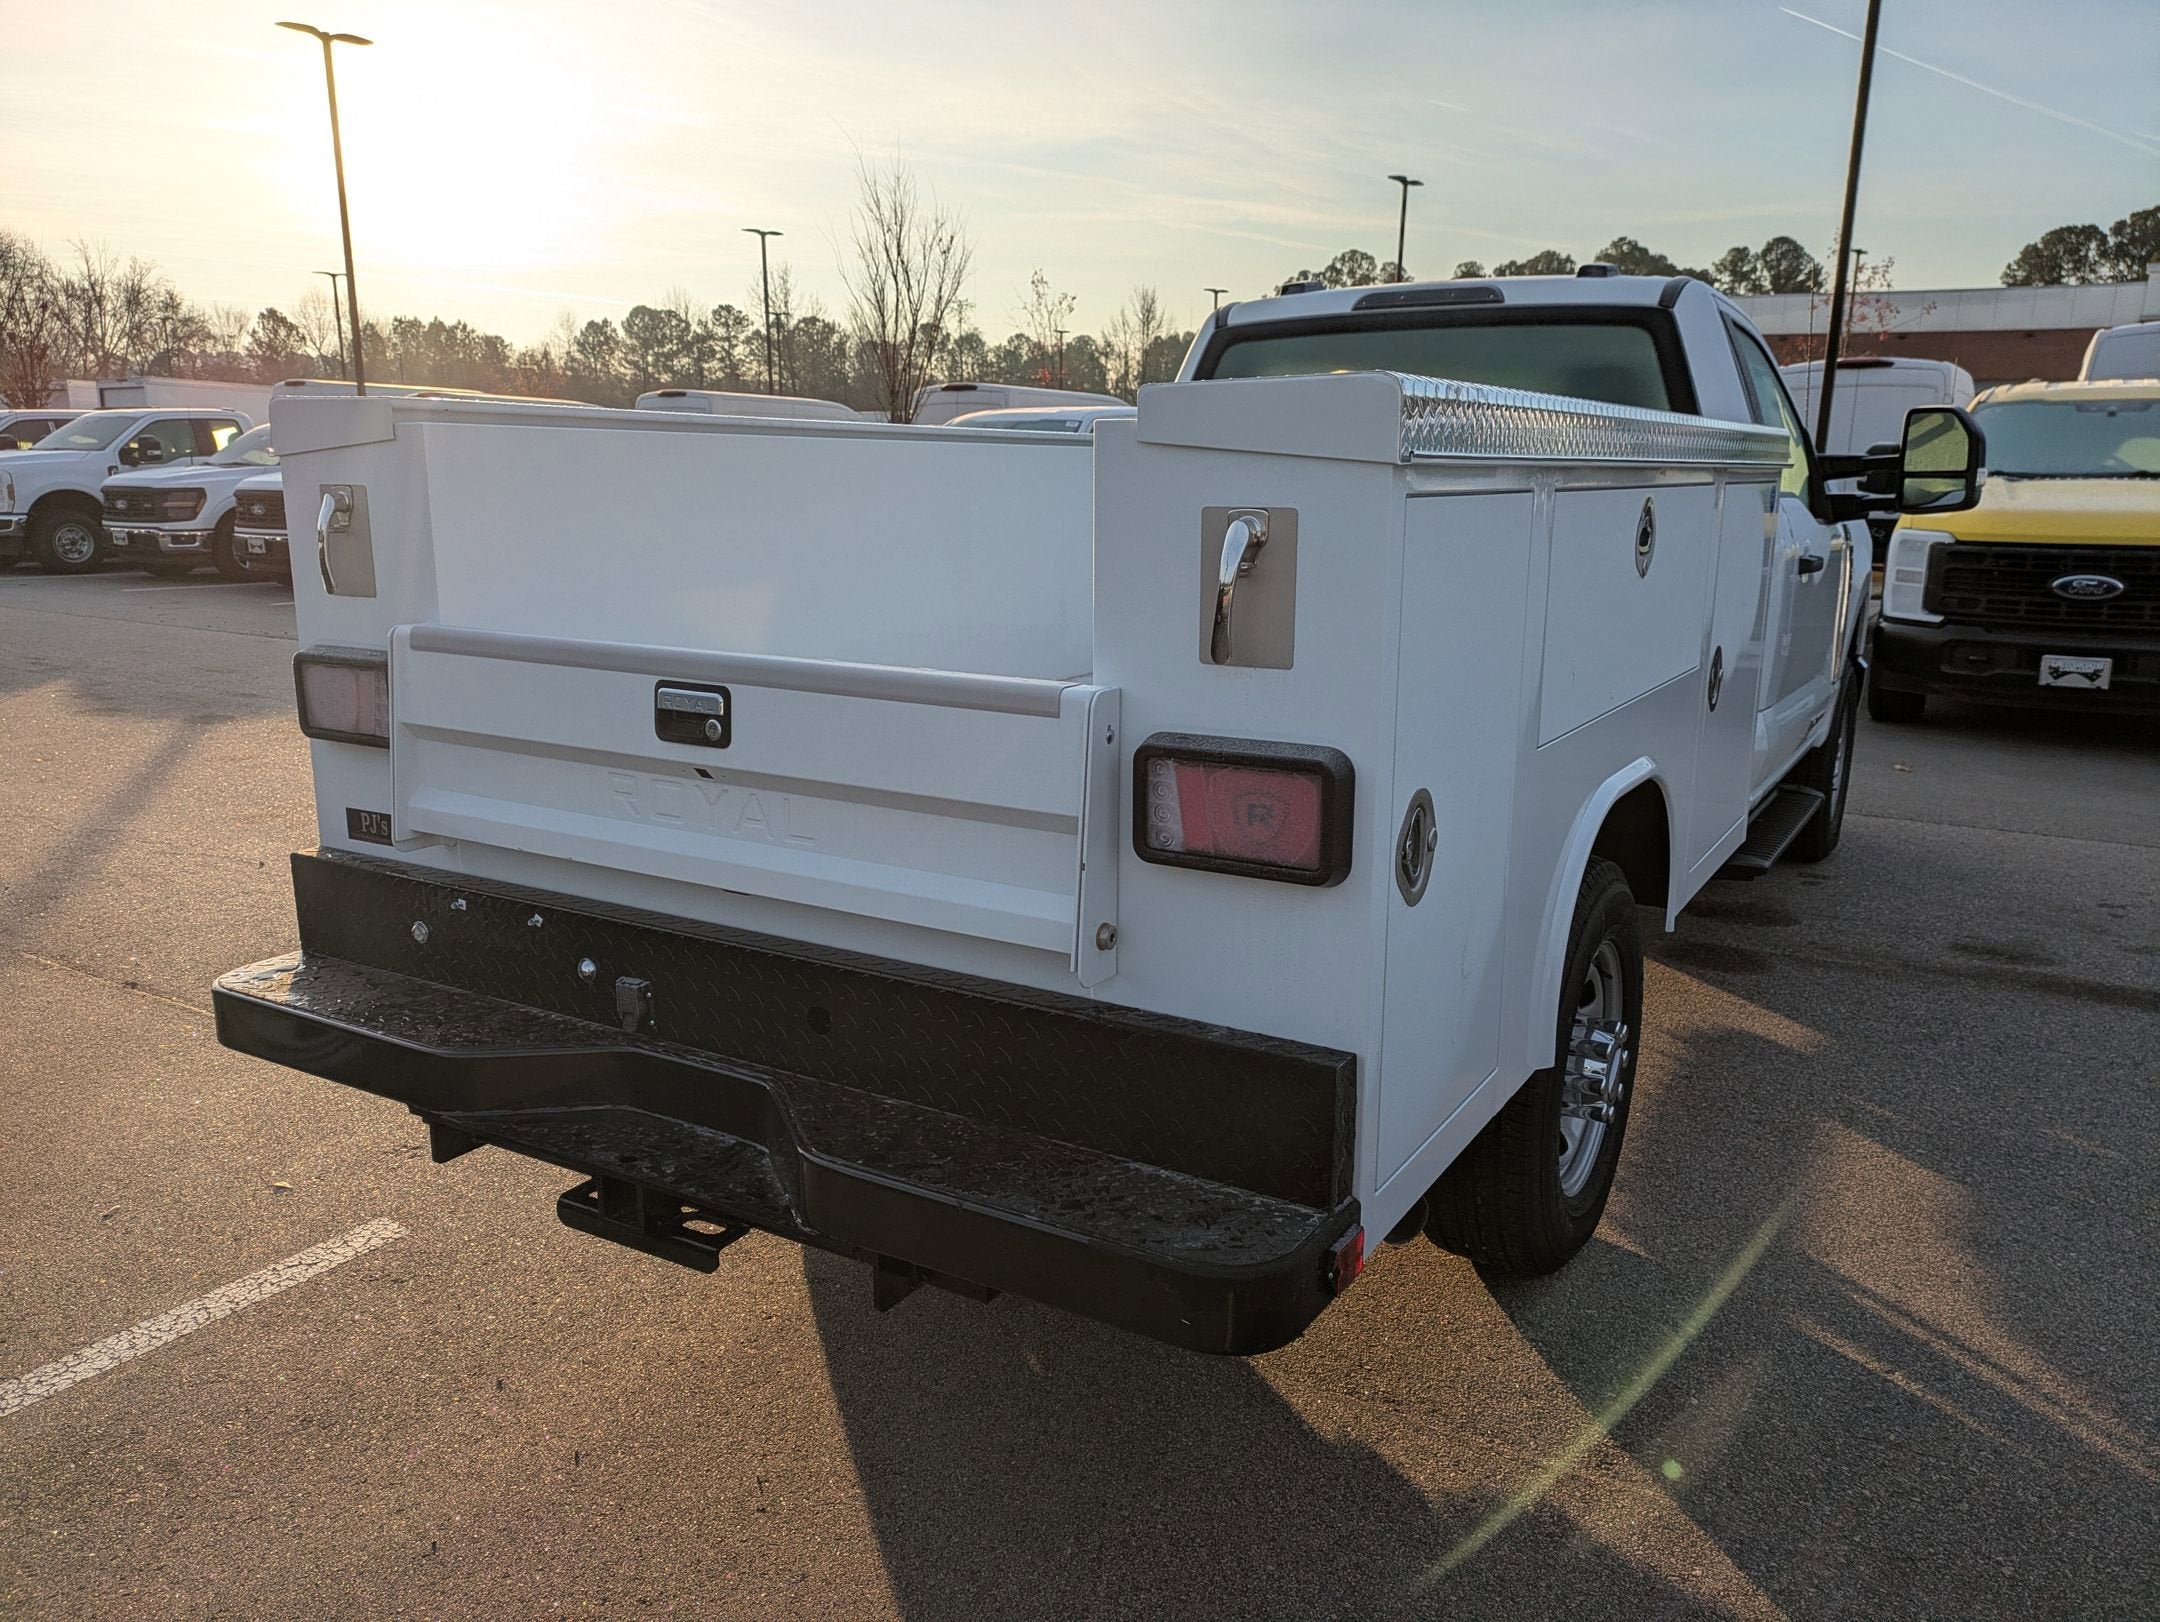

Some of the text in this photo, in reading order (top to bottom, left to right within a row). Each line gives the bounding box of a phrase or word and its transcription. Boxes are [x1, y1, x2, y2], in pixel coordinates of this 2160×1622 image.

[664, 694, 716, 713] ROYAL
[607, 771, 815, 848] ROYAL
[360, 812, 389, 836] PJ's
